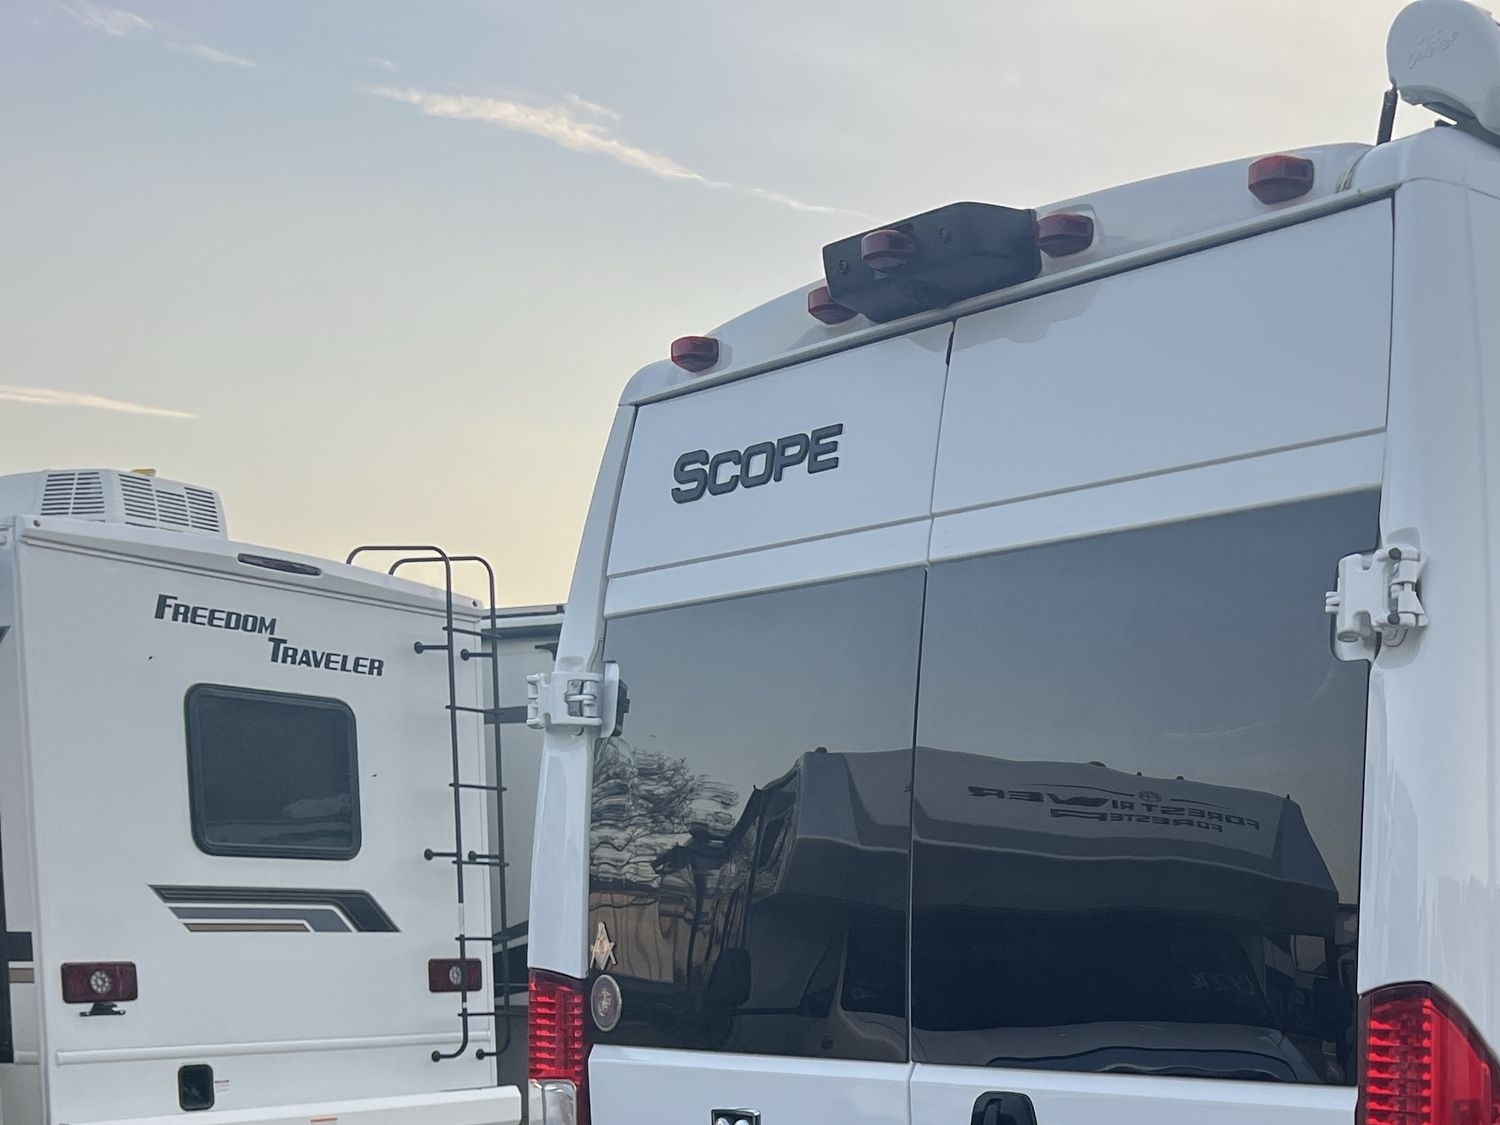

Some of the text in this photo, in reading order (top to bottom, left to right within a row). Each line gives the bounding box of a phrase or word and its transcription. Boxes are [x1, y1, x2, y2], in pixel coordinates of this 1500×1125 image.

[671, 423, 843, 504] SCOPE
[154, 594, 277, 635] FREEDOM
[267, 637, 384, 677] TRAVELER
